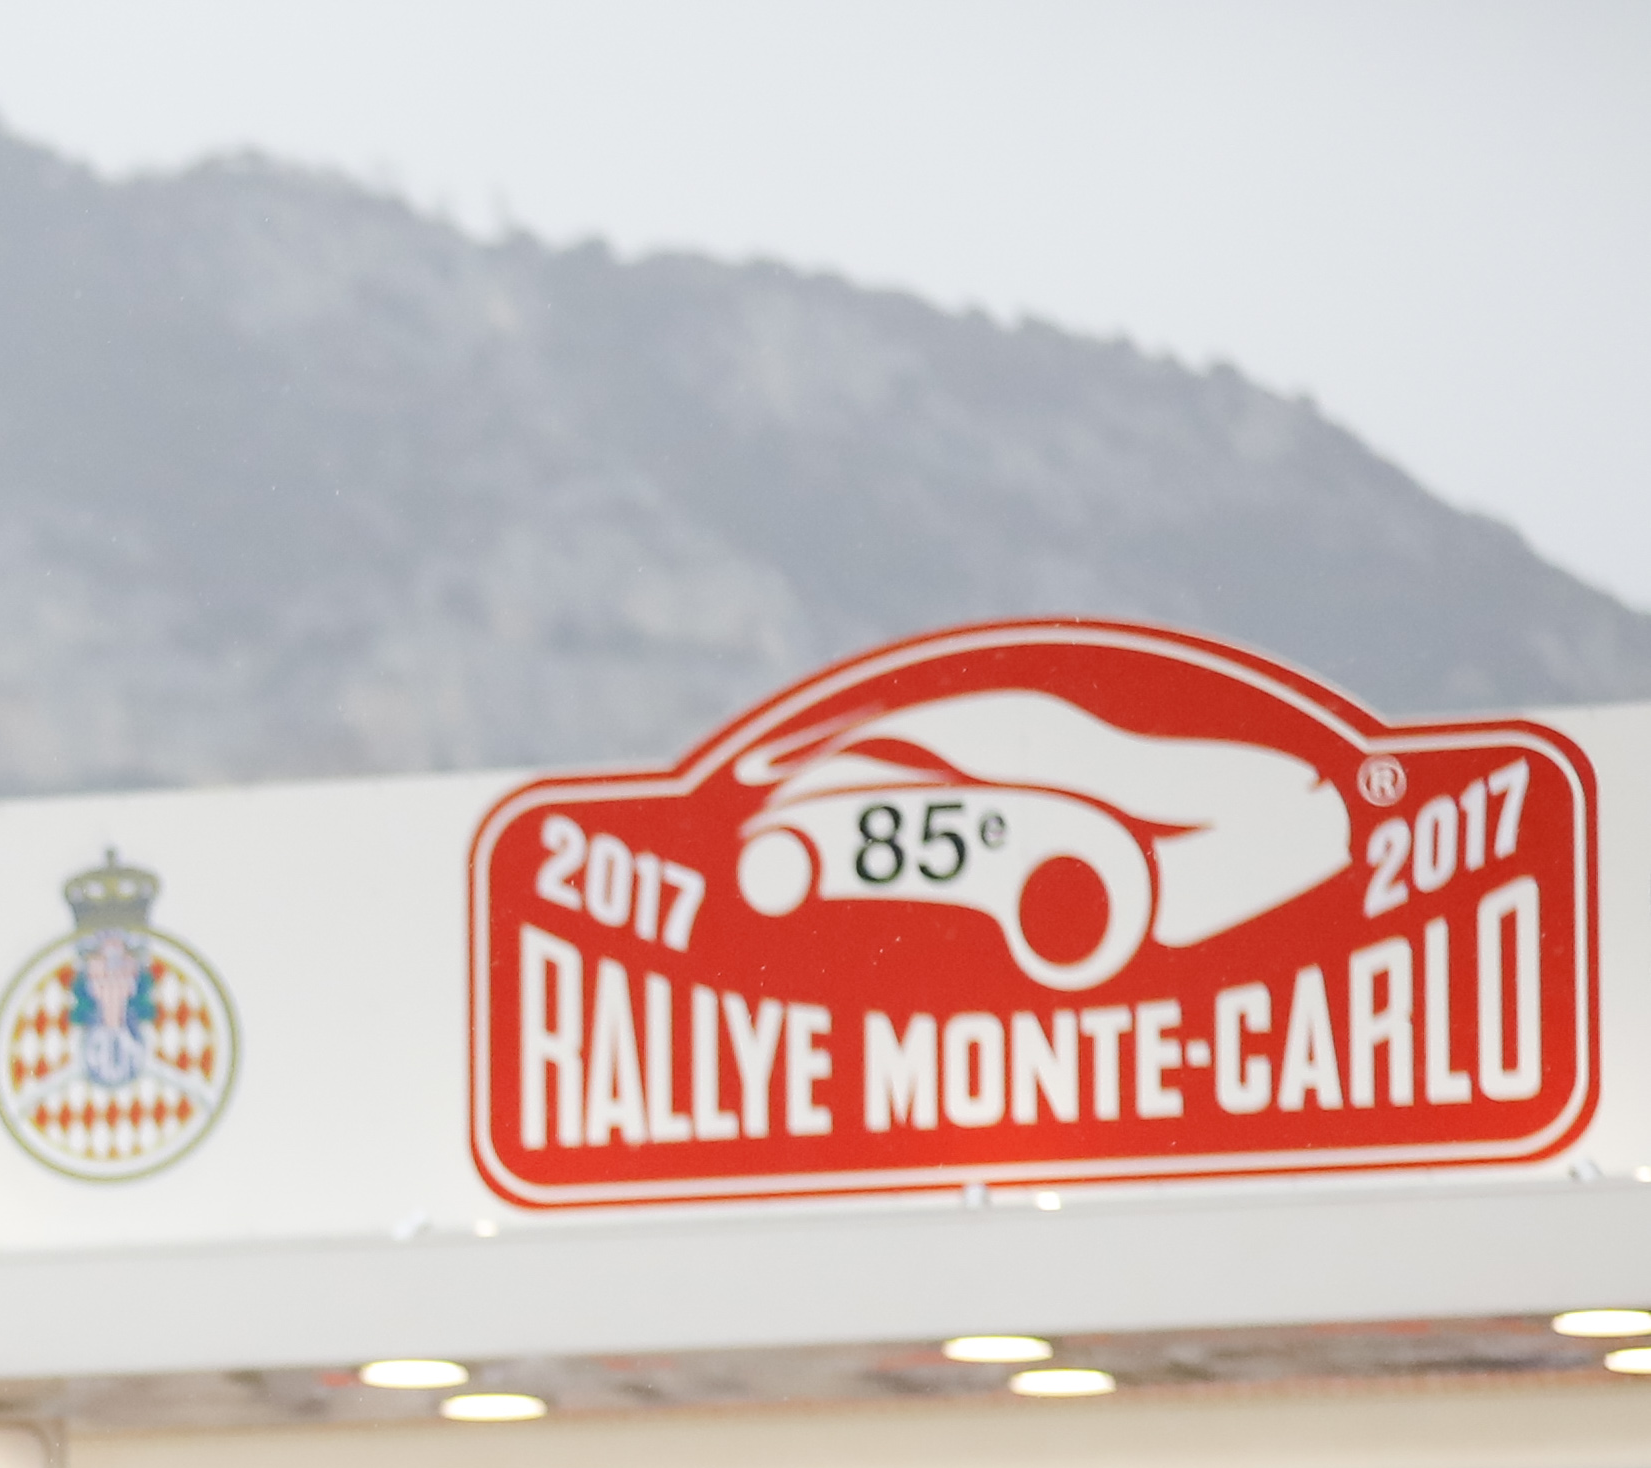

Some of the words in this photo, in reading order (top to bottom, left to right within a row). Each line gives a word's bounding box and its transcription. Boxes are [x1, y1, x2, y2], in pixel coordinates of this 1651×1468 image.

[538, 817, 706, 950] 2017
[1366, 759, 1529, 917] 2017
[520, 923, 832, 1149] RALLYE
[865, 876, 1541, 1133] MONTE-CARLO
